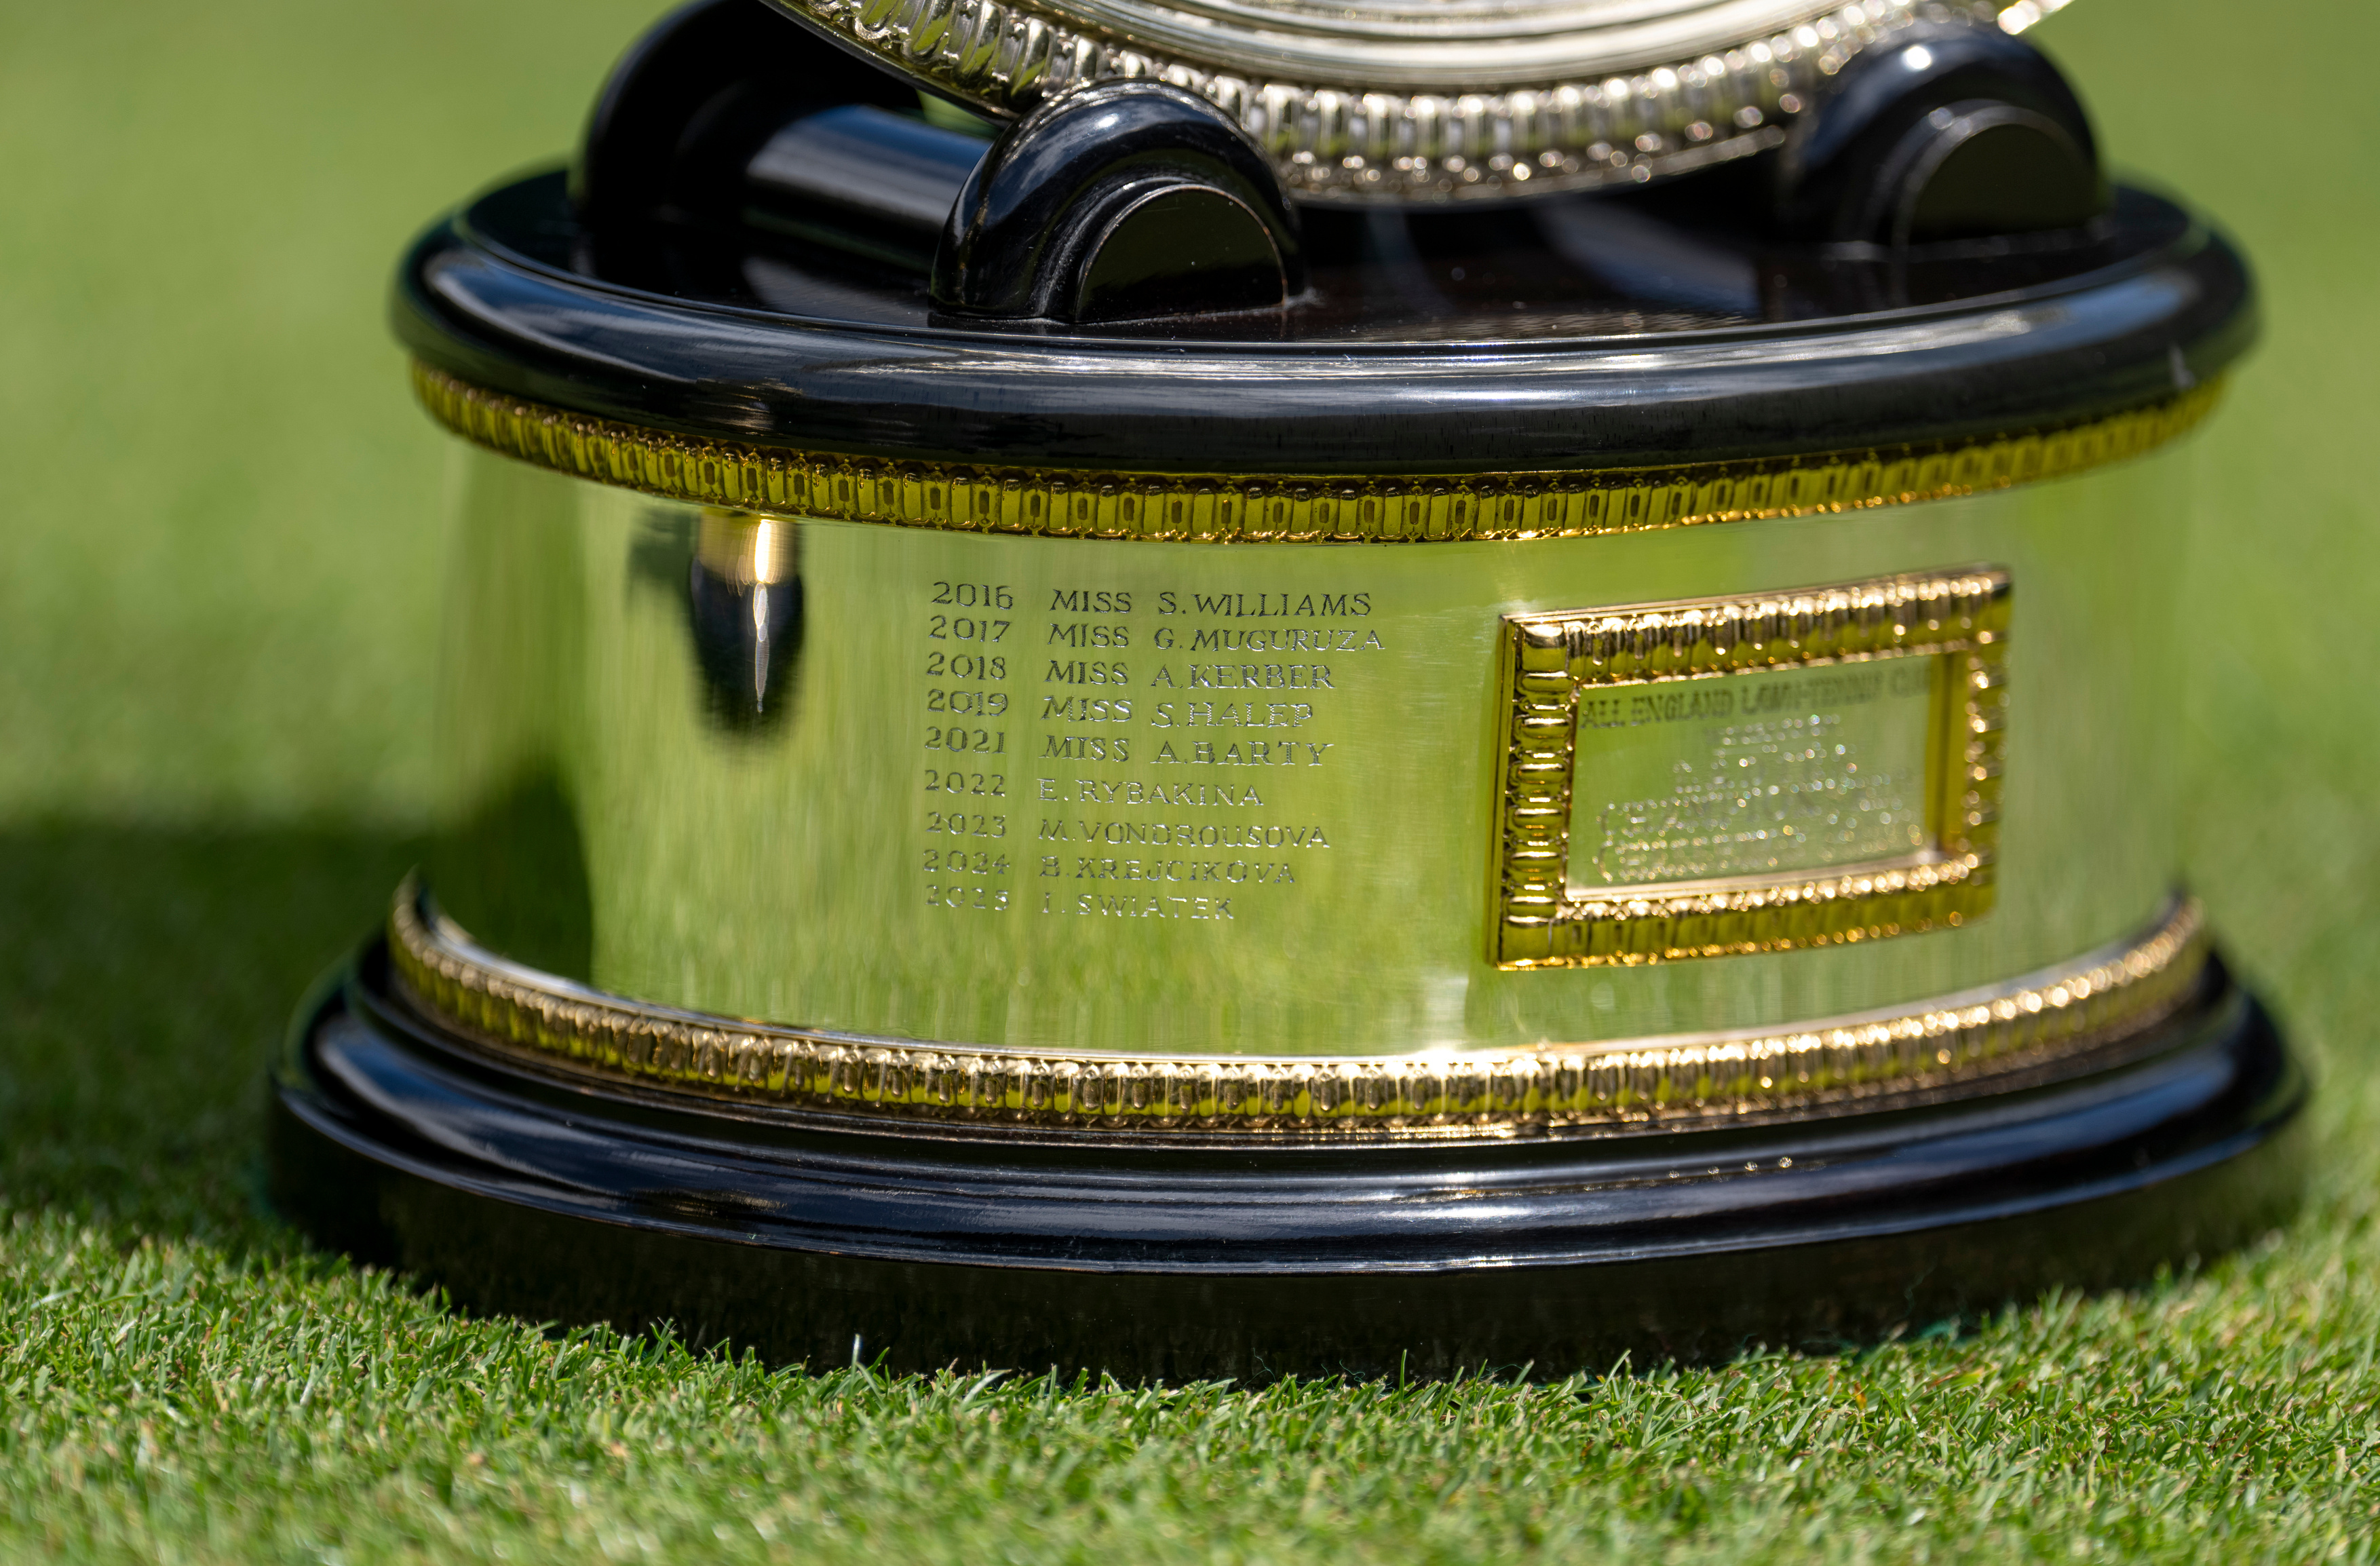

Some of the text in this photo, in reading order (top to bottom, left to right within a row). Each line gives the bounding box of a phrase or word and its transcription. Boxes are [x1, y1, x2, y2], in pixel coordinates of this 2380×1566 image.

[931, 581, 1014, 611] 2016
[1050, 590, 1132, 614] MISS
[928, 615, 1010, 643] 2017
[1048, 623, 1130, 649] MISS
[927, 651, 1337, 689] 2018 MISS A.KERBER
[927, 688, 1314, 727] 2019 MISS S.HALEP
[925, 725, 1335, 767] 2021 MISS A.BARTY
[925, 769, 1005, 797] 2022
[925, 812, 1007, 838] 2023
[923, 849, 1010, 875] 2024
[925, 885, 1010, 911] 2025
